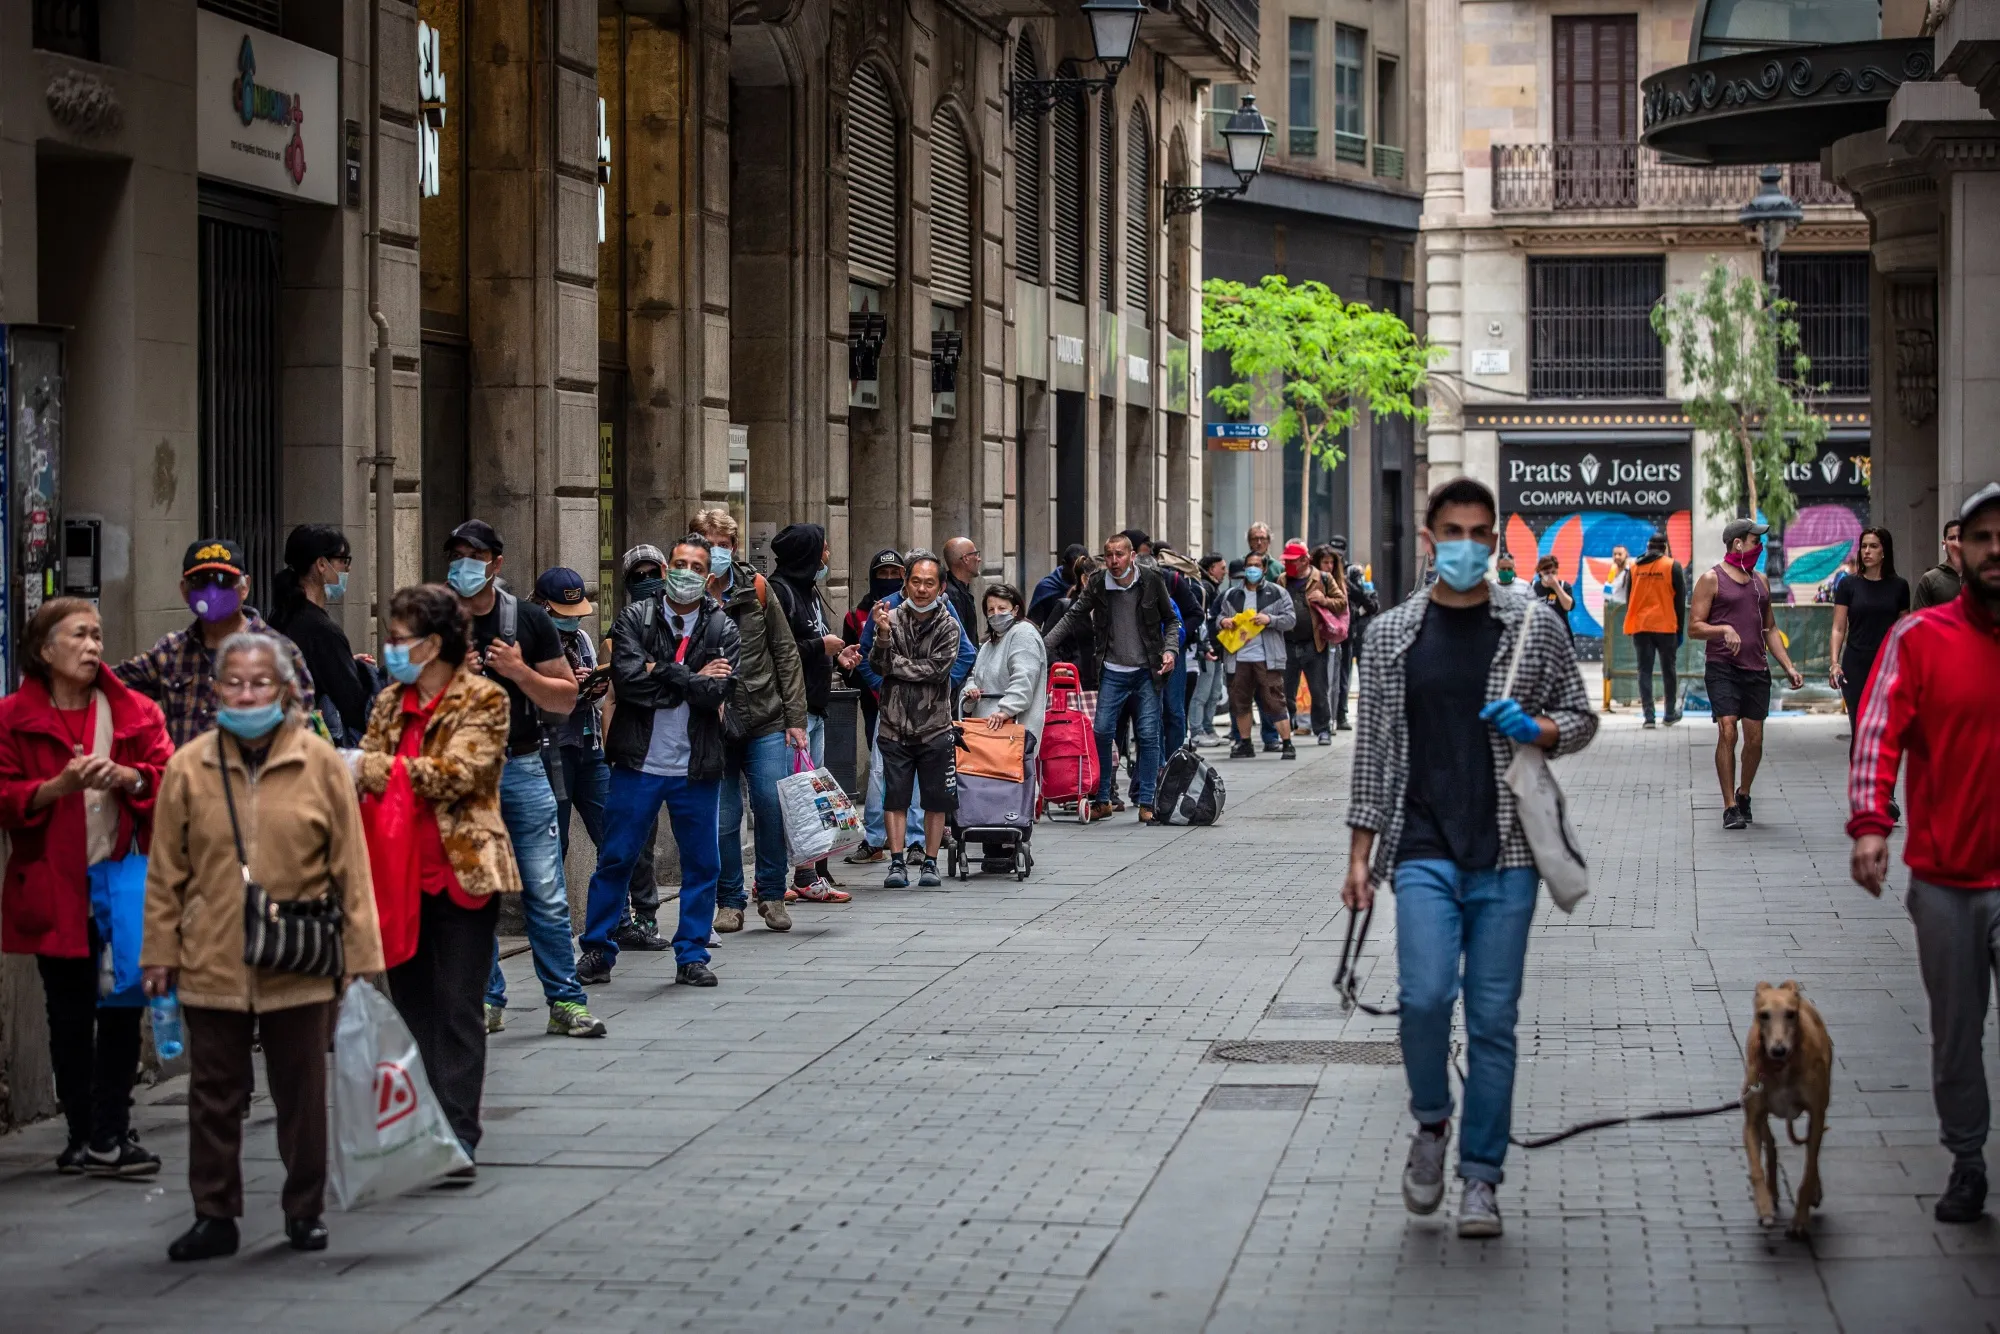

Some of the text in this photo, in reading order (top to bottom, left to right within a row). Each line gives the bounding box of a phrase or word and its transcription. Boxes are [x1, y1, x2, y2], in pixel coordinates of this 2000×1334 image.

[1509, 459, 1681, 486] Prats Joiers
[1519, 490, 1671, 506] COMPRA VENTA ORO
